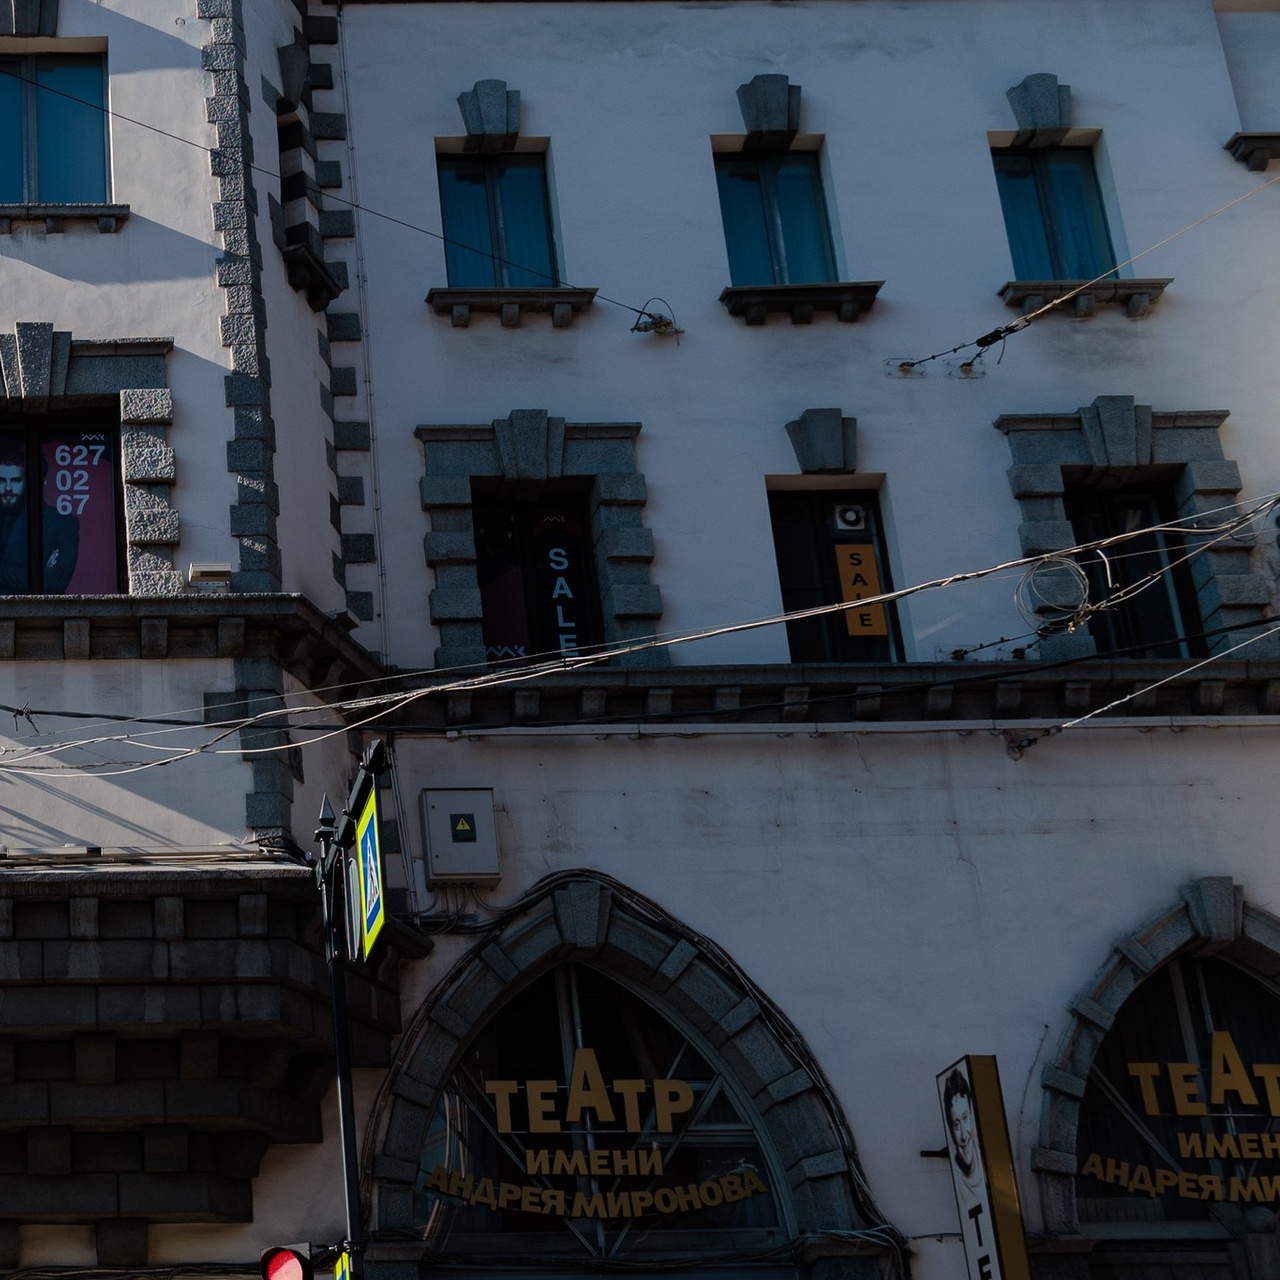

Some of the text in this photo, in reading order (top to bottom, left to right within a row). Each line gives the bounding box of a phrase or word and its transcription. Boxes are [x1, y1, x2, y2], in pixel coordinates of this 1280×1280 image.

[55, 445, 105, 466] 627
[56, 470, 89, 491] 02
[56, 494, 90, 516] 67
[548, 547, 579, 657] SALE
[485, 1048, 694, 1134] ТЕАТР
[525, 1149, 664, 1176] ИМЕНИ
[1081, 1153, 1223, 1201] АНДРЕЯ
[424, 1165, 767, 1219] АНДРЕЯ МИРОНОВА
